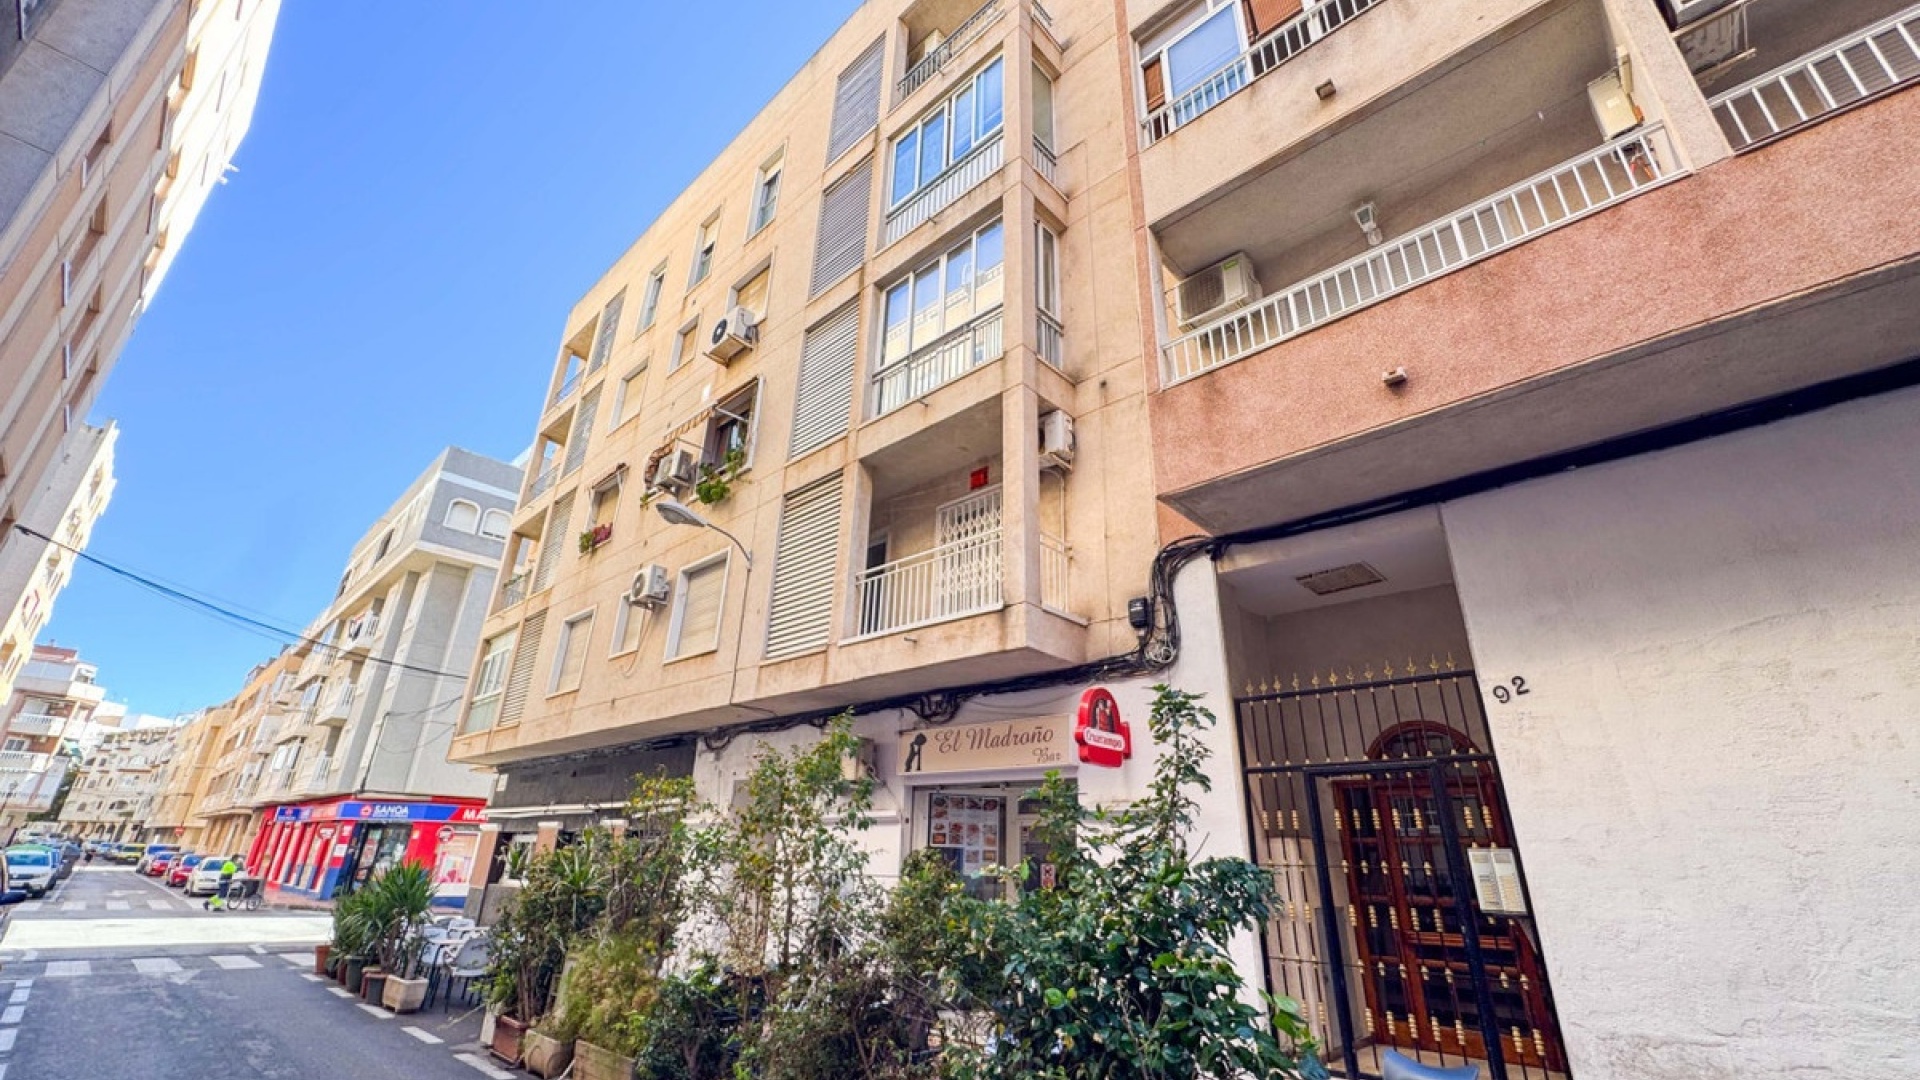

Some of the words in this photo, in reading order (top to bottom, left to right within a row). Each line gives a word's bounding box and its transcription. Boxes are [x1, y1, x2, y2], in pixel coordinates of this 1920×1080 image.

[1493, 676, 1530, 704] 92
[934, 729, 961, 753] El
[966, 724, 1054, 750] Madroño
[1086, 729, 1123, 749] Cruzcampo
[1032, 747, 1061, 763] Bar
